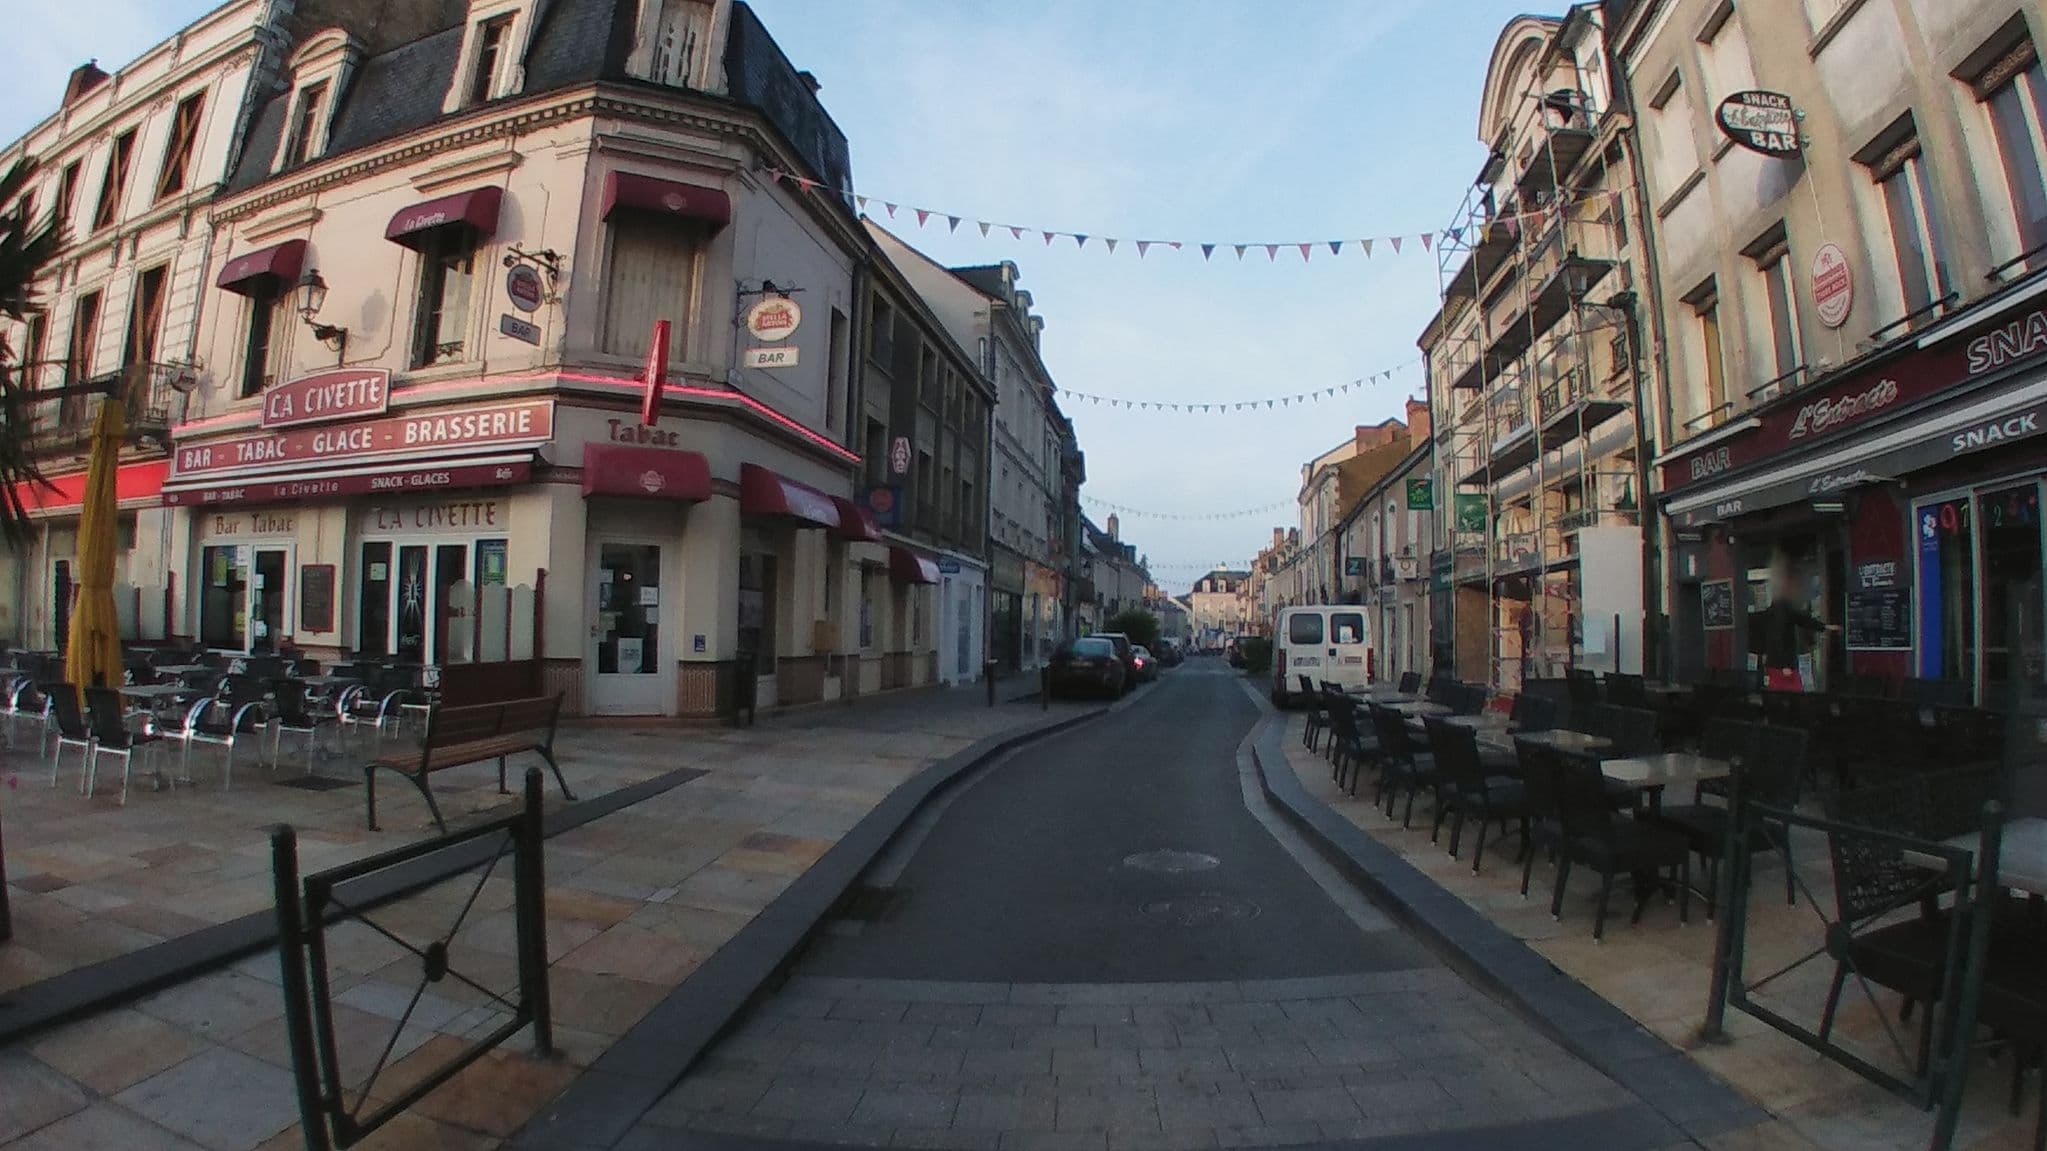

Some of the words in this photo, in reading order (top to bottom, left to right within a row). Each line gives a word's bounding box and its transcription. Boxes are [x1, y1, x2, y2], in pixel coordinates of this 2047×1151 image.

[1742, 94, 1788, 109] SNACK
[1750, 132, 1799, 151] BAR
[511, 322, 531, 337] BAR
[758, 352, 785, 364] BAR
[270, 394, 293, 419] LA
[304, 376, 382, 413] CIVETTE
[184, 448, 211, 469] BAR
[236, 438, 288, 462] TABAC
[312, 427, 373, 453] GLACE
[404, 409, 532, 444] BRASSERIE
[607, 418, 681, 446] Tabac
[1952, 412, 2039, 452] SNACK
[1691, 447, 1732, 480] BAR
[377, 508, 403, 530] LA
[415, 502, 497, 528] CIVETTE
[1716, 500, 1742, 516] BAR
[215, 515, 241, 535] Bar
[250, 512, 294, 533] Tabac
